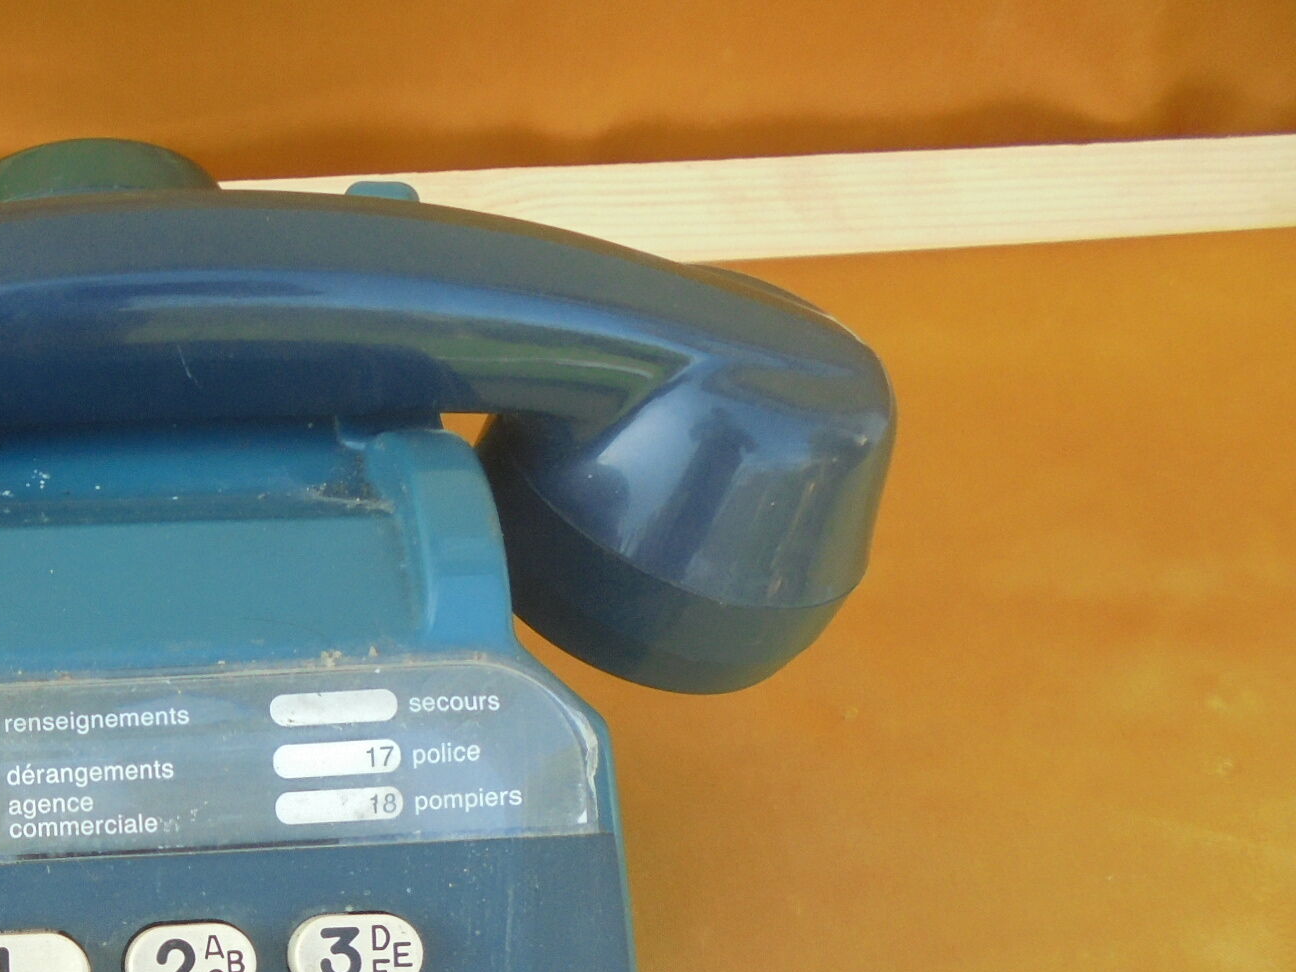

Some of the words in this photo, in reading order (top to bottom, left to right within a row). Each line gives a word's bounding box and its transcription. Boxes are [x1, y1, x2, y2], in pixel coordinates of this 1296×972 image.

[408, 693, 501, 712] secours
[4, 707, 190, 735] renseignements
[366, 746, 395, 768] 17
[412, 744, 481, 769] police
[6, 760, 174, 788] dérangements
[8, 796, 94, 819] agence
[370, 793, 398, 815] 18
[414, 789, 523, 815] pompiers
[9, 814, 158, 839] commerciale
